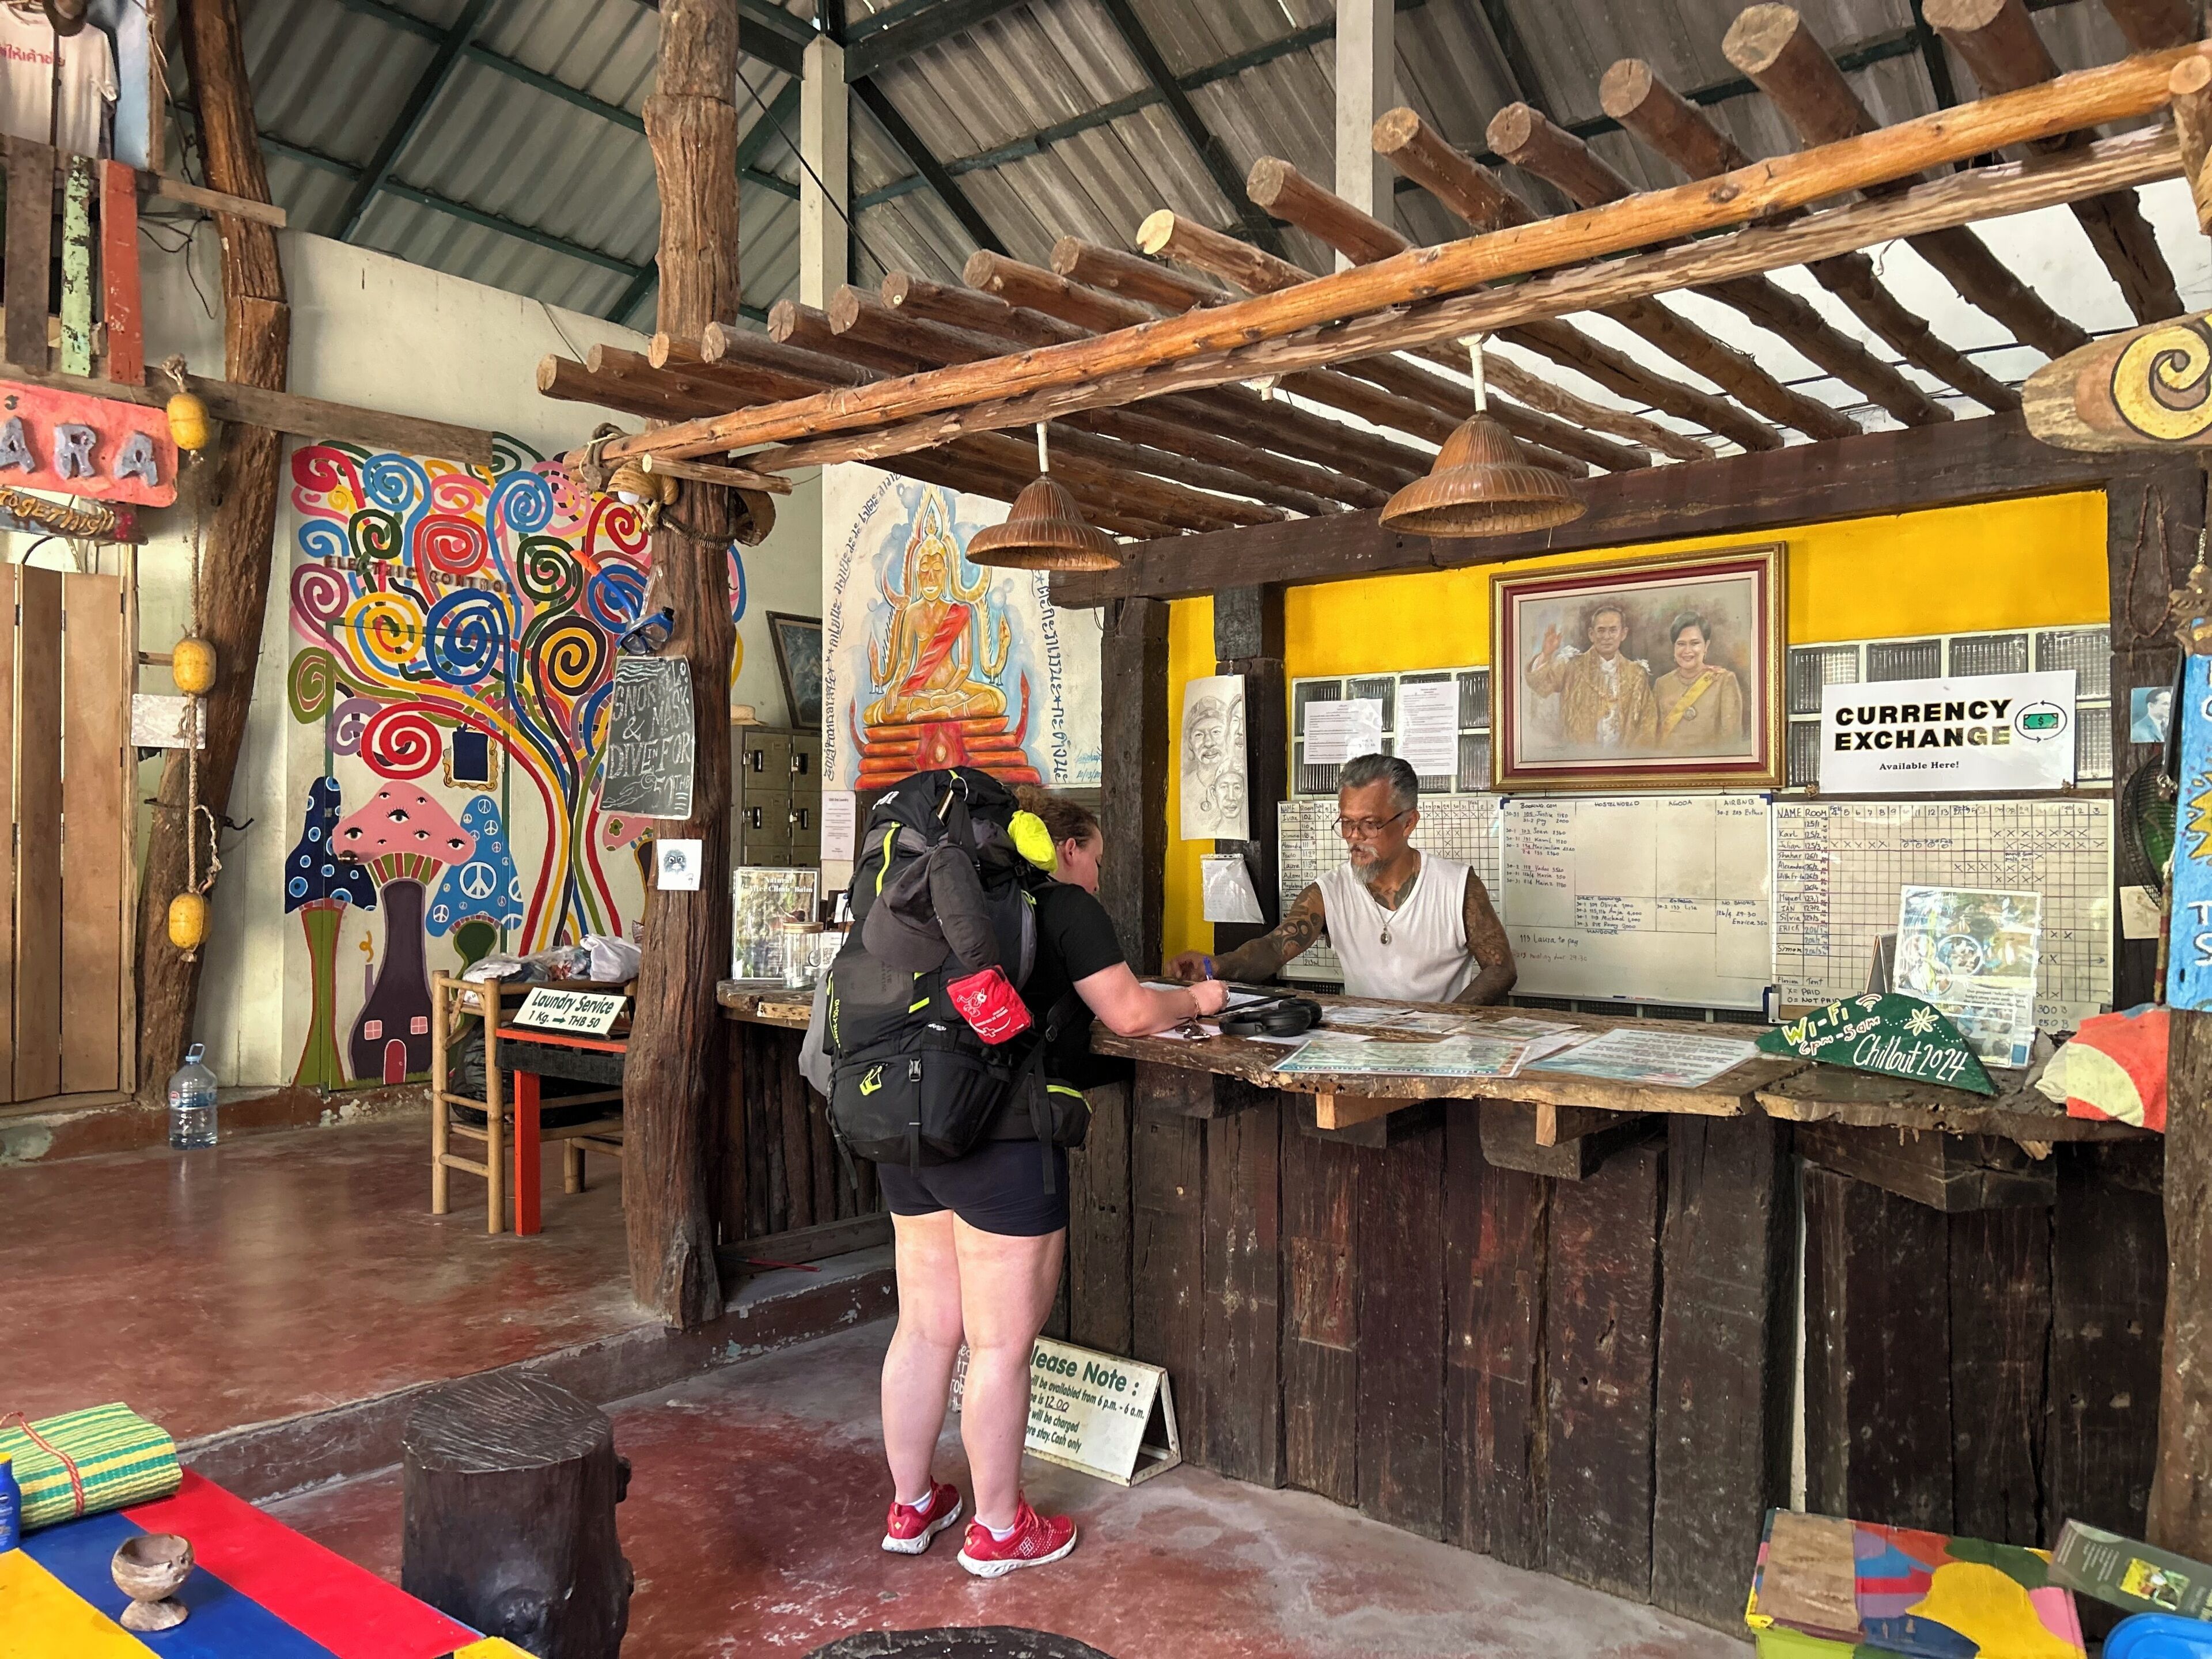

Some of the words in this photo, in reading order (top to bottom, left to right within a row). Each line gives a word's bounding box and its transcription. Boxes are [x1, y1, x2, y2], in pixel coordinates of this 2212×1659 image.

[1835, 698, 2013, 726] CURRENCY
[1834, 725, 2011, 752] EXCHANGE
[1879, 762, 1927, 771] Available
[1931, 760, 1960, 770] Here!
[1778, 807, 1802, 818] NAME
[1779, 830, 1798, 838] Karl
[1533, 933, 1556, 944] Laura
[1558, 935, 1566, 944] to
[1801, 988, 1820, 996] PAID
[532, 990, 577, 1015] Laundry
[574, 995, 615, 1014] Service
[2036, 1004, 2058, 1015] 300
[528, 1010, 536, 1020] 1
[536, 1012, 550, 1025] Kg.
[568, 1015, 588, 1027] THB
[587, 1017, 601, 1028] 50
[2038, 1019, 2059, 1027] 250
[1853, 1033, 1922, 1075] Chillout
[1916, 1041, 1969, 1082] 2024
[1030, 1345, 1077, 1377] lease
[1082, 1361, 1127, 1392] Note
[1037, 1392, 1044, 1405] is
[1039, 1376, 1048, 1389] be
[1081, 1389, 1097, 1405] from
[1097, 1395, 1104, 1406] 6
[1101, 1399, 1117, 1411] p.m.
[1124, 1403, 1130, 1415] 6
[1130, 1407, 1145, 1420] a.m.
[1031, 1409, 1044, 1422] will
[1043, 1411, 1053, 1425] be
[1052, 1415, 1081, 1434] charged
[1051, 1431, 1067, 1447] Cash
[1067, 1438, 1082, 1454] only
